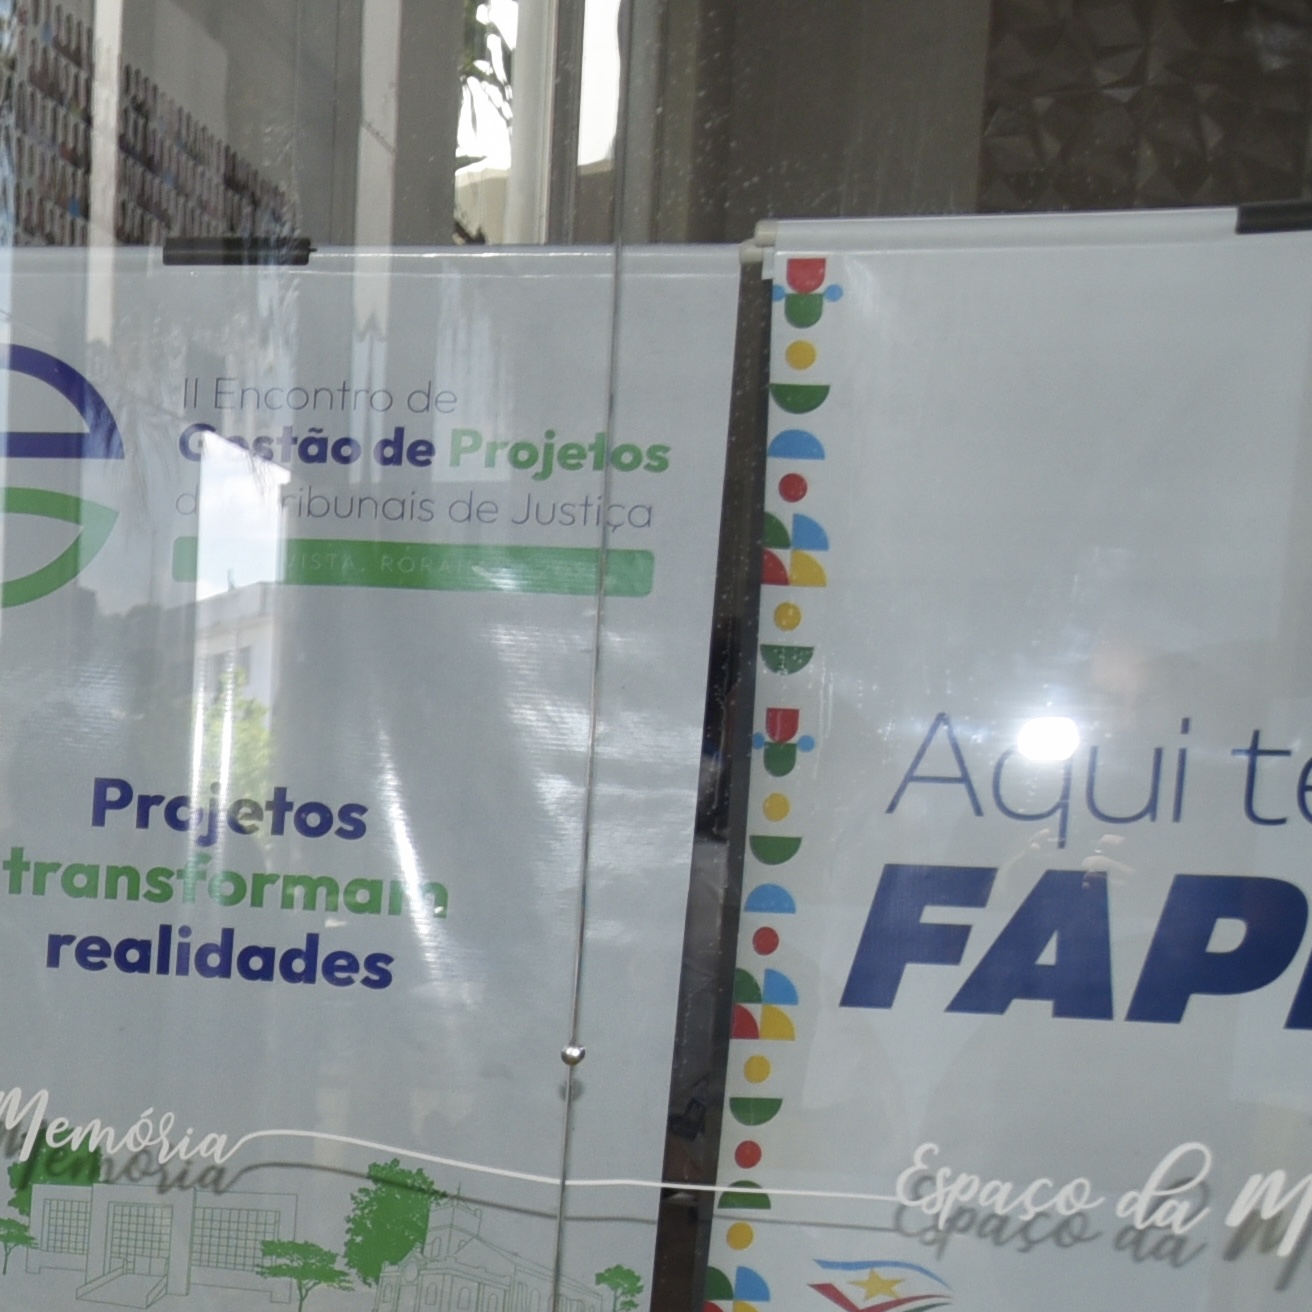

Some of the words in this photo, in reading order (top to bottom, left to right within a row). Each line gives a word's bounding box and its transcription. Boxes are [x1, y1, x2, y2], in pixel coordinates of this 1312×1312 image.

[183, 377, 199, 409] II
[214, 378, 394, 413] Encontro
[407, 380, 458, 414] de
[373, 426, 436, 468] de
[449, 428, 672, 481] Projetos
[278, 485, 434, 523] ribunais
[448, 491, 499, 524] de
[511, 493, 653, 533] Justiça
[91, 777, 369, 848] Projetos
[885, 712, 1191, 850] Aqui
[1231, 729, 1312, 827] t
[2, 847, 449, 919] transformam
[46, 924, 394, 989] realidades
[838, 863, 1312, 1030] FAP
[895, 1142, 1106, 1231] Espaço
[1116, 1142, 1212, 1235] da
